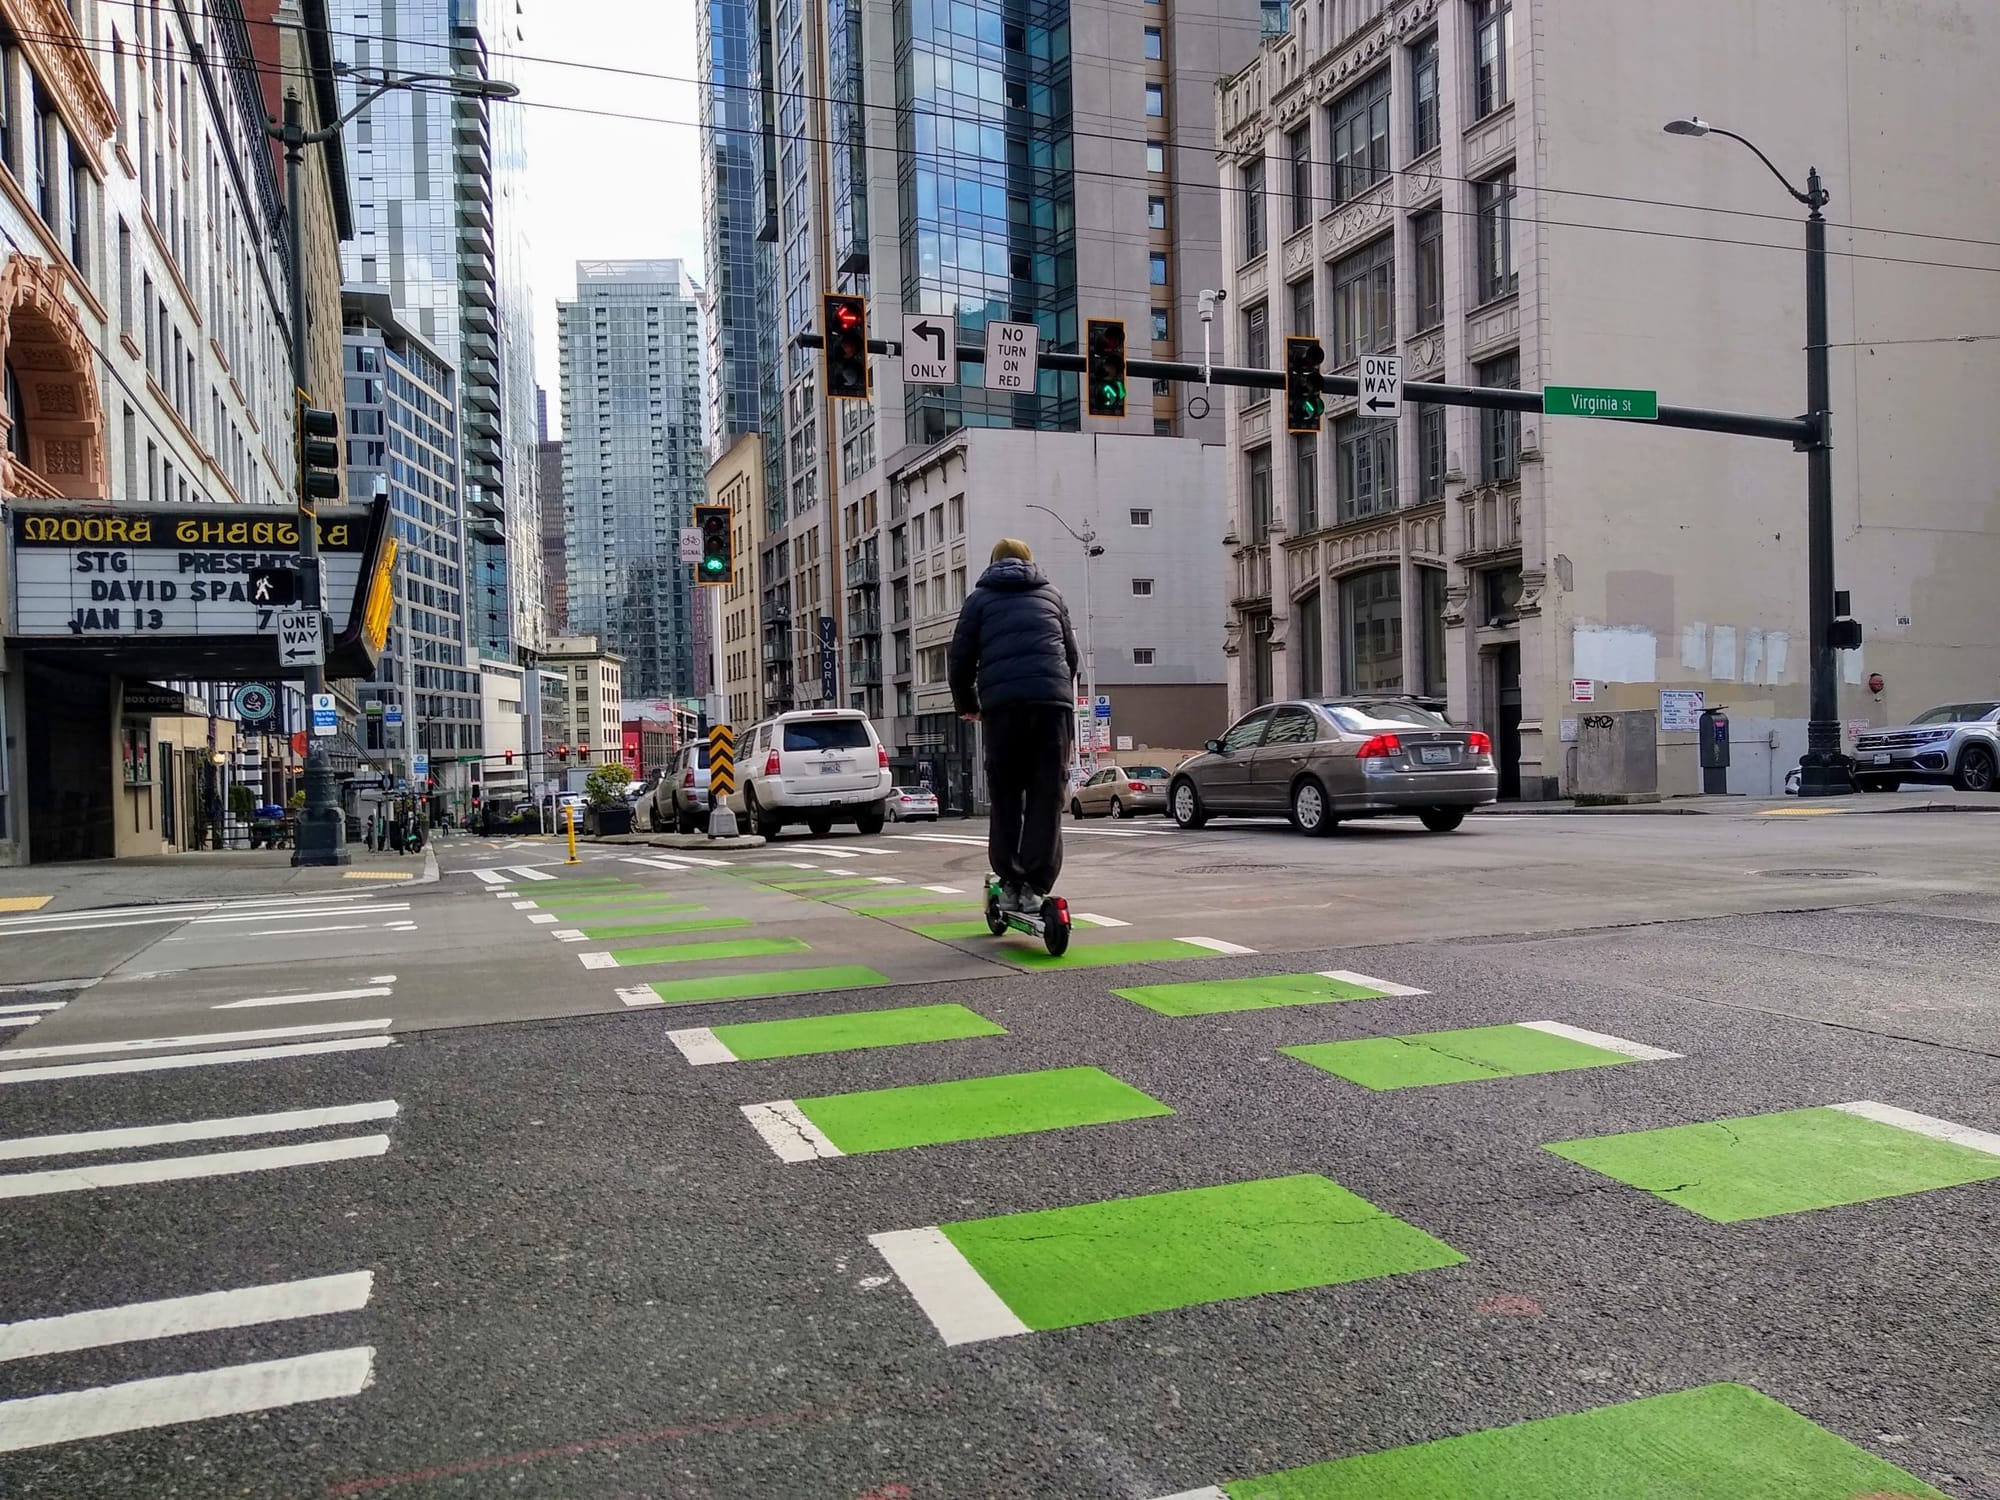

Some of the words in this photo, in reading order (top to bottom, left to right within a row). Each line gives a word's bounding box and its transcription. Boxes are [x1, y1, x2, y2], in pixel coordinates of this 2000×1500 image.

[1002, 328, 1024, 342] NO
[997, 344, 1027, 358] TURN
[911, 364, 947, 379] ONLY
[1003, 361, 1019, 373] ON
[1366, 360, 1395, 375] ONE
[999, 374, 1021, 387] RED
[1365, 376, 1397, 393] WAY
[1571, 393, 1618, 415] Virginia
[1622, 400, 1632, 412] St
[24, 517, 152, 542] MOORE
[76, 551, 128, 573] STG
[91, 580, 177, 602] DAVID
[190, 580, 251, 602] SPA
[76, 608, 120, 630] JAN
[137, 609, 164, 630] 13
[258, 609, 273, 630] 7
[282, 615, 317, 629] ONE
[283, 631, 318, 645] WAY
[822, 622, 833, 697] VIKTORIA
[125, 696, 146, 704] BOX
[148, 695, 183, 704] OFFICE
